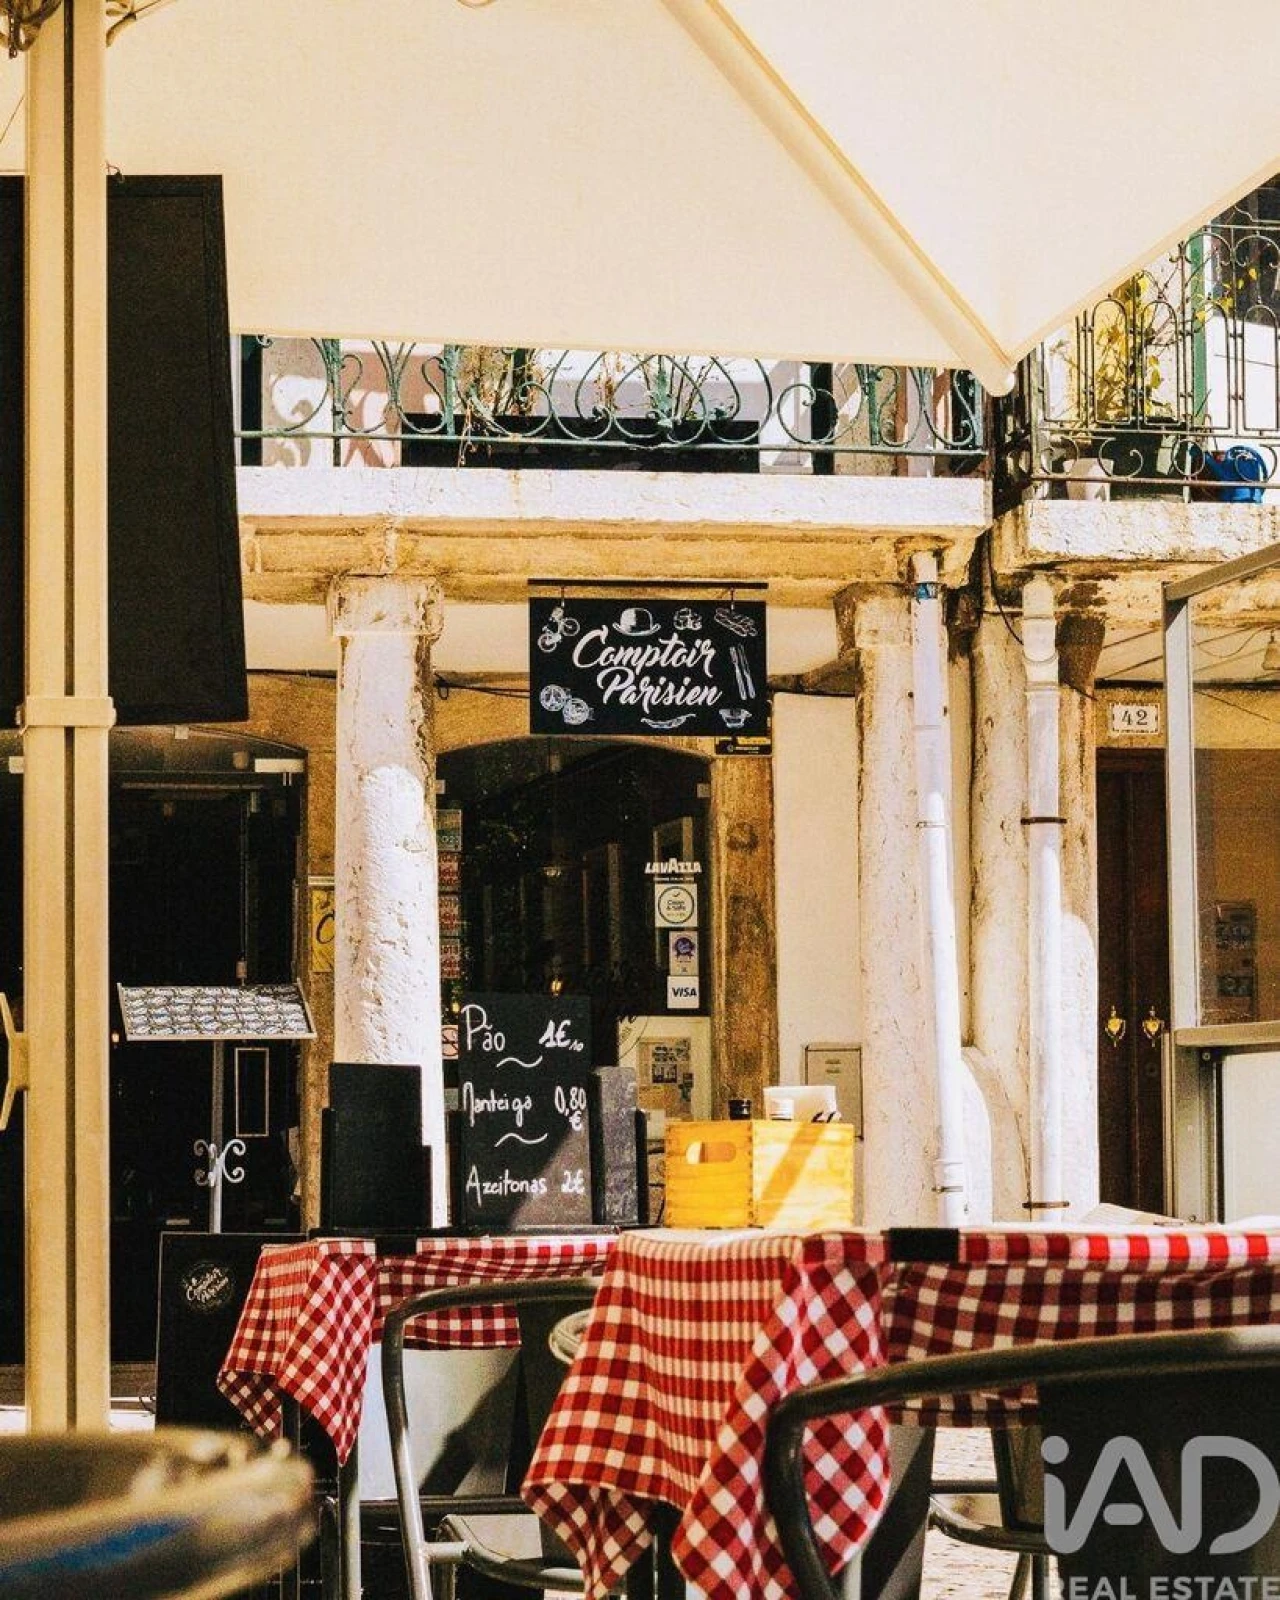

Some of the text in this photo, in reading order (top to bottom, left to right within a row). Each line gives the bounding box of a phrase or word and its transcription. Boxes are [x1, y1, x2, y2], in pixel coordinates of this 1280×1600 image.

[572, 624, 716, 679] Comptoir
[596, 666, 722, 714] Parisien
[1122, 709, 1148, 725] 42
[644, 858, 702, 874] LAVAZZA
[672, 987, 698, 998] VISA
[460, 1004, 506, 1052] Pão
[465, 1165, 585, 1207] Azeitonas 2€
